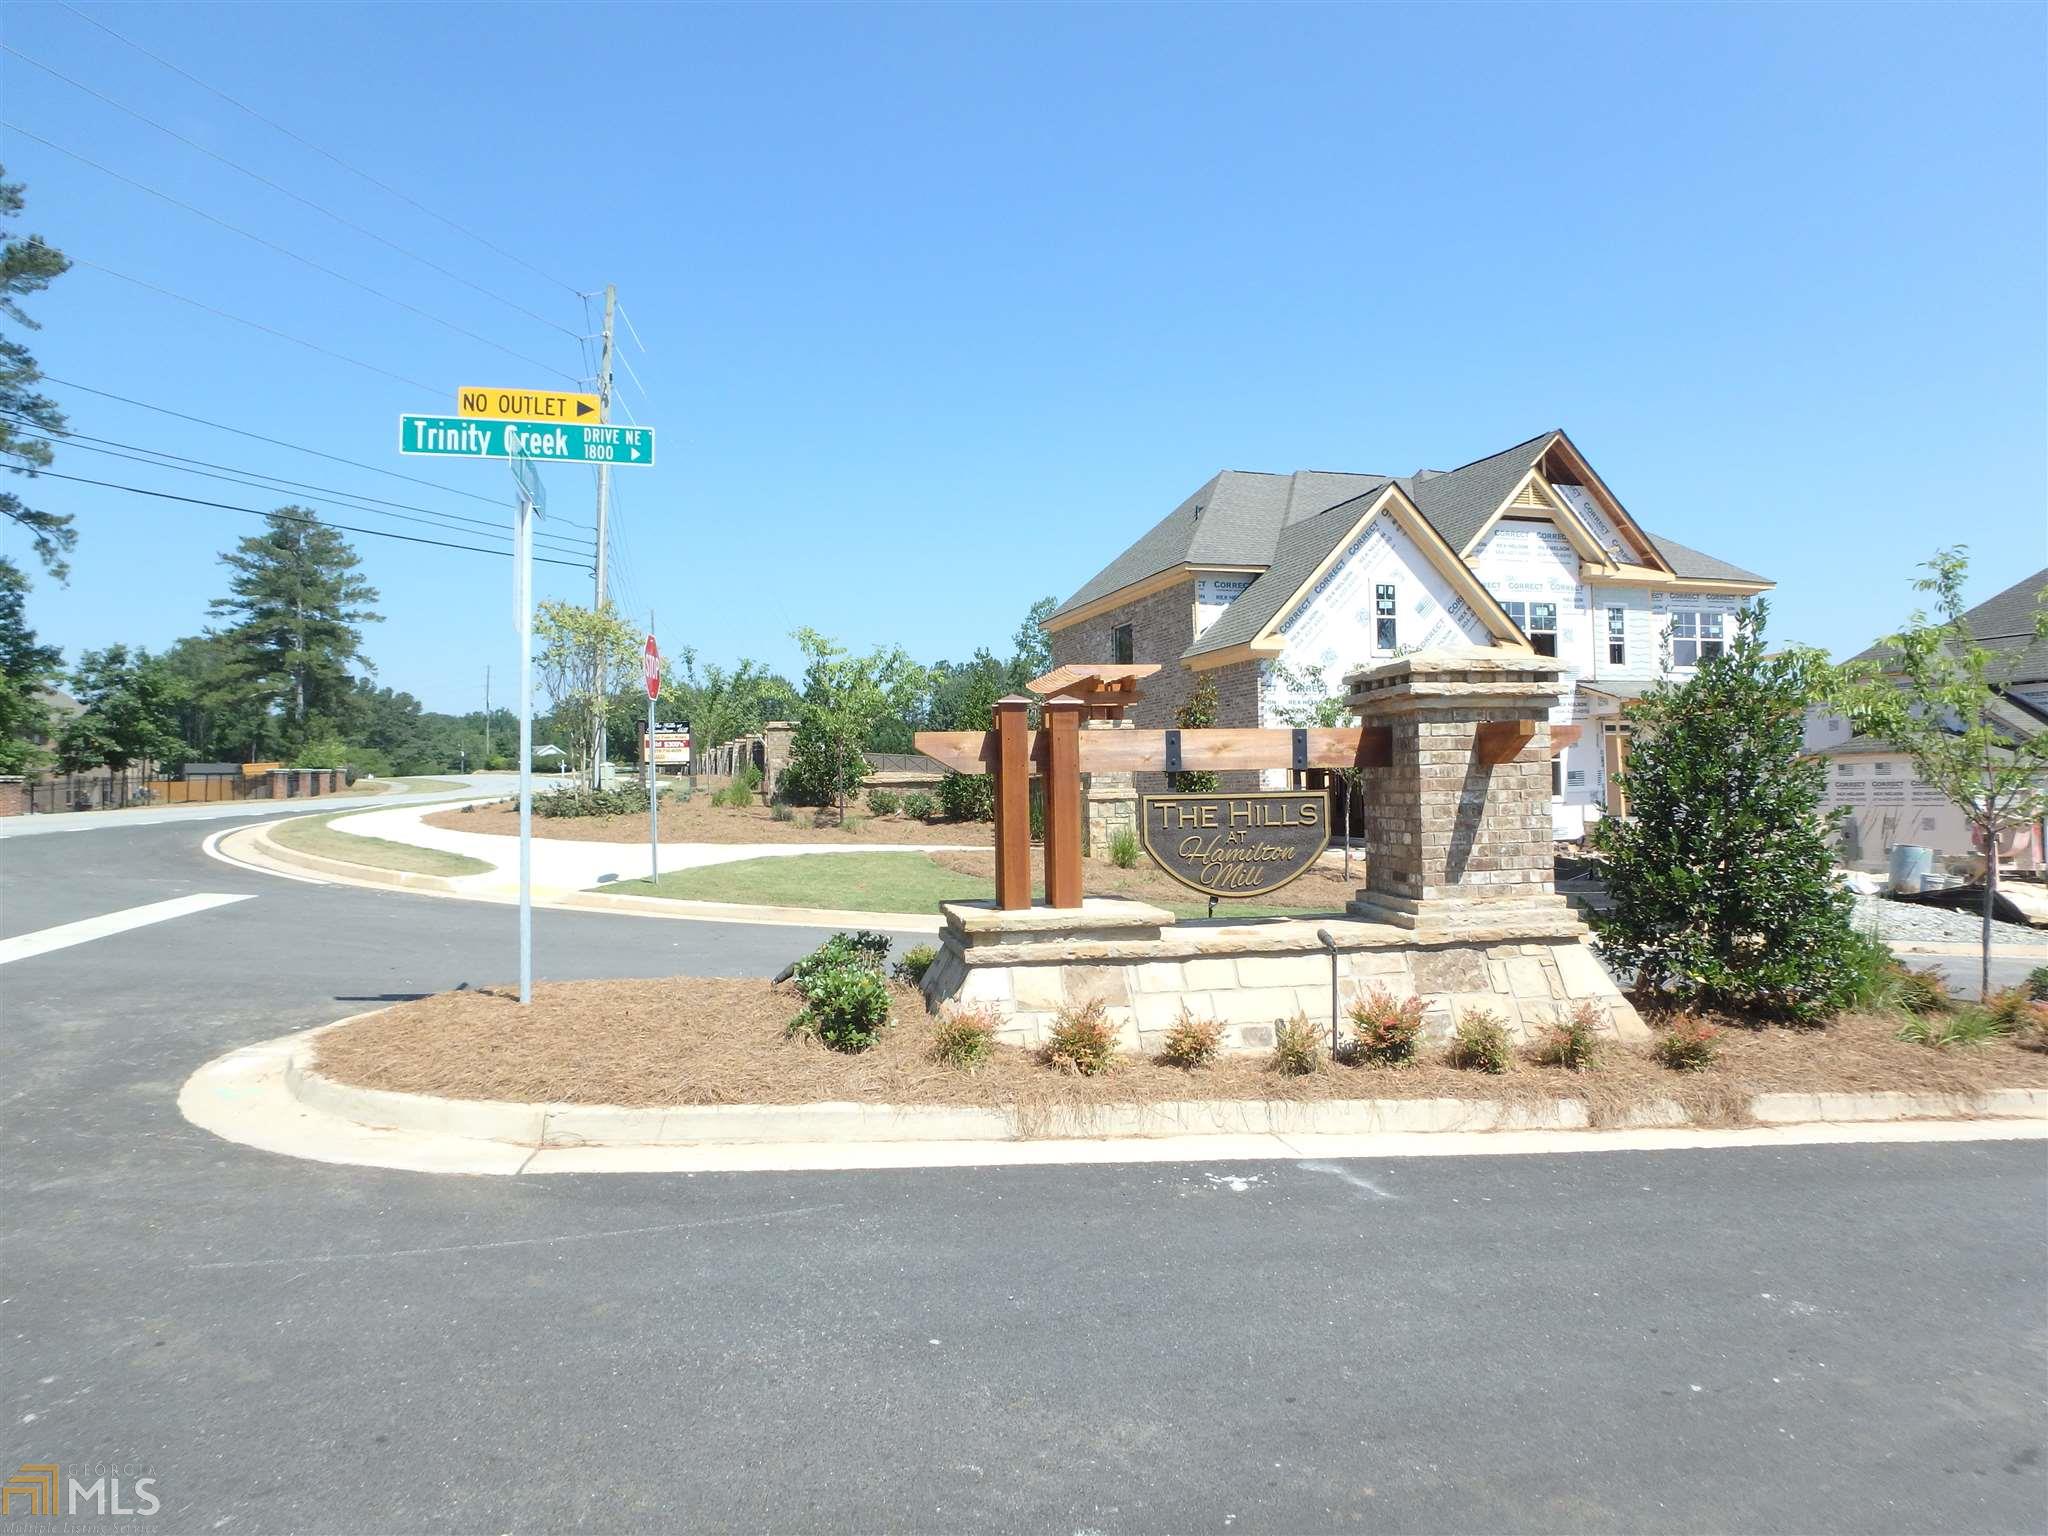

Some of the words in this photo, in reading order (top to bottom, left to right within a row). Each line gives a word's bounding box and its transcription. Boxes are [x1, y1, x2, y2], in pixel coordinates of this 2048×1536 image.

[463, 393, 487, 413] NO
[499, 395, 566, 416] OUTLET
[414, 421, 491, 456] Trinity
[504, 425, 568, 456] Creek
[583, 428, 620, 445] DRIVE
[625, 431, 642, 446] NE
[584, 444, 614, 461] 1800
[1280, 598, 1311, 634] CORRECT
[1314, 559, 1345, 594] CORRECT
[1348, 520, 1379, 556] CORRECT
[646, 653, 660, 681] STOP
[1153, 802, 1219, 829] THE
[1229, 800, 1319, 828] HILLS
[1178, 834, 1296, 866] Hamilton
[1226, 830, 1247, 845] AT
[1200, 861, 1265, 889] Mill
